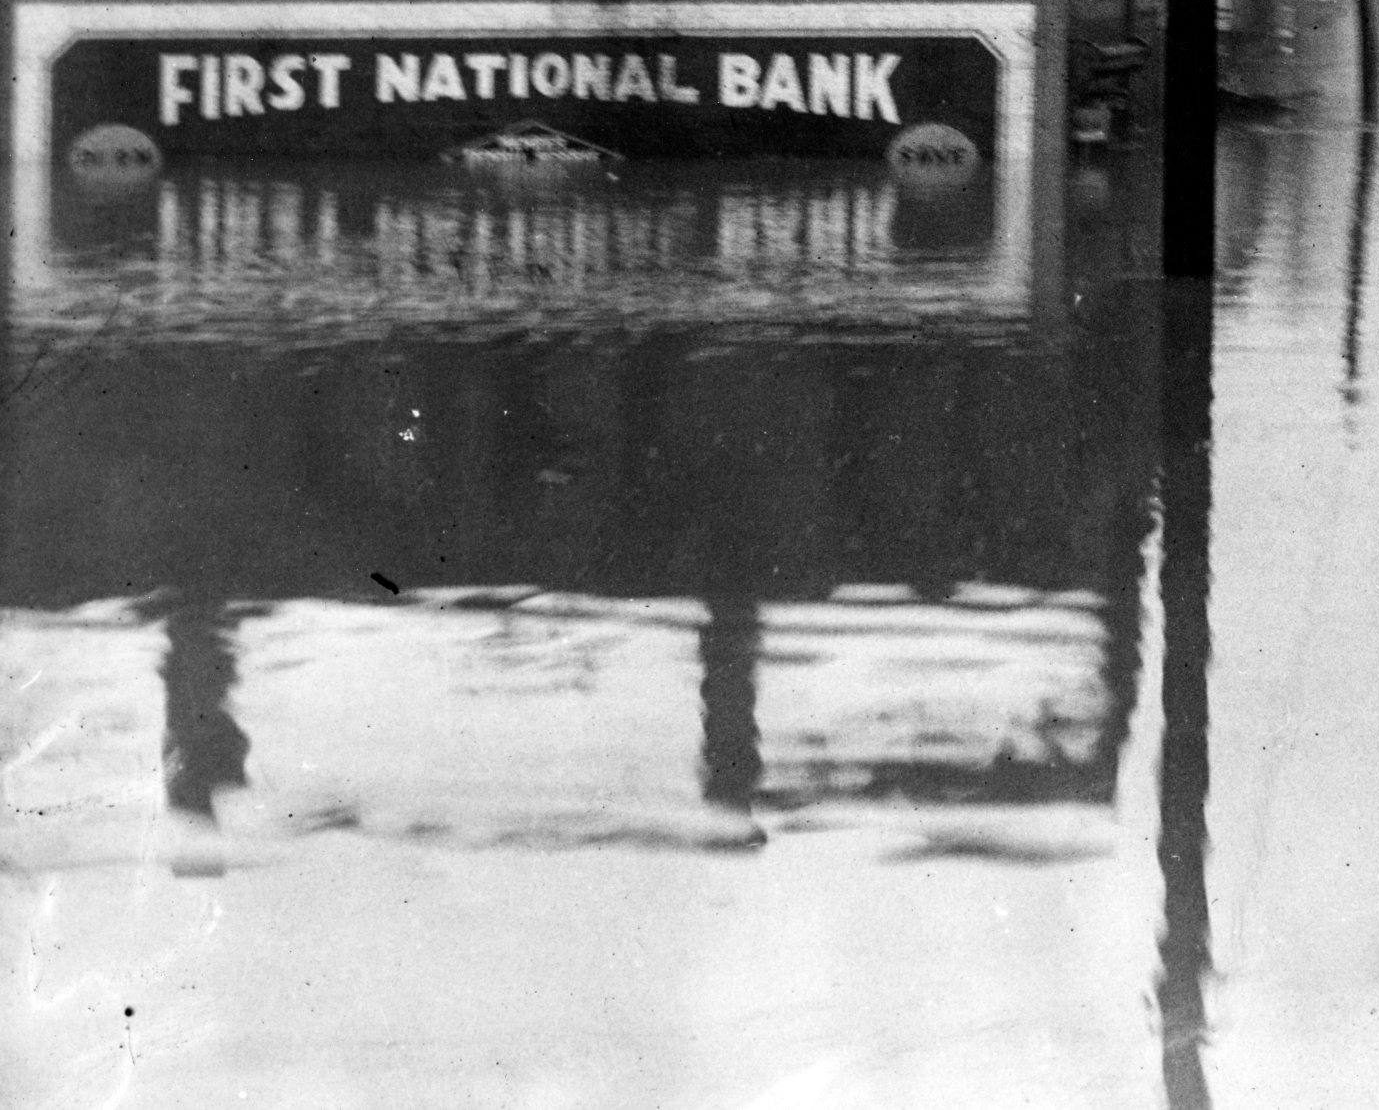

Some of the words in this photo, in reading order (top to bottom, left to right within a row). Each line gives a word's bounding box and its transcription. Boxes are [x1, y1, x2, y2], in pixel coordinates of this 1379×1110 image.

[160, 53, 352, 125] FIRST
[377, 52, 700, 104] NATIONAL
[717, 52, 904, 126] BANK
